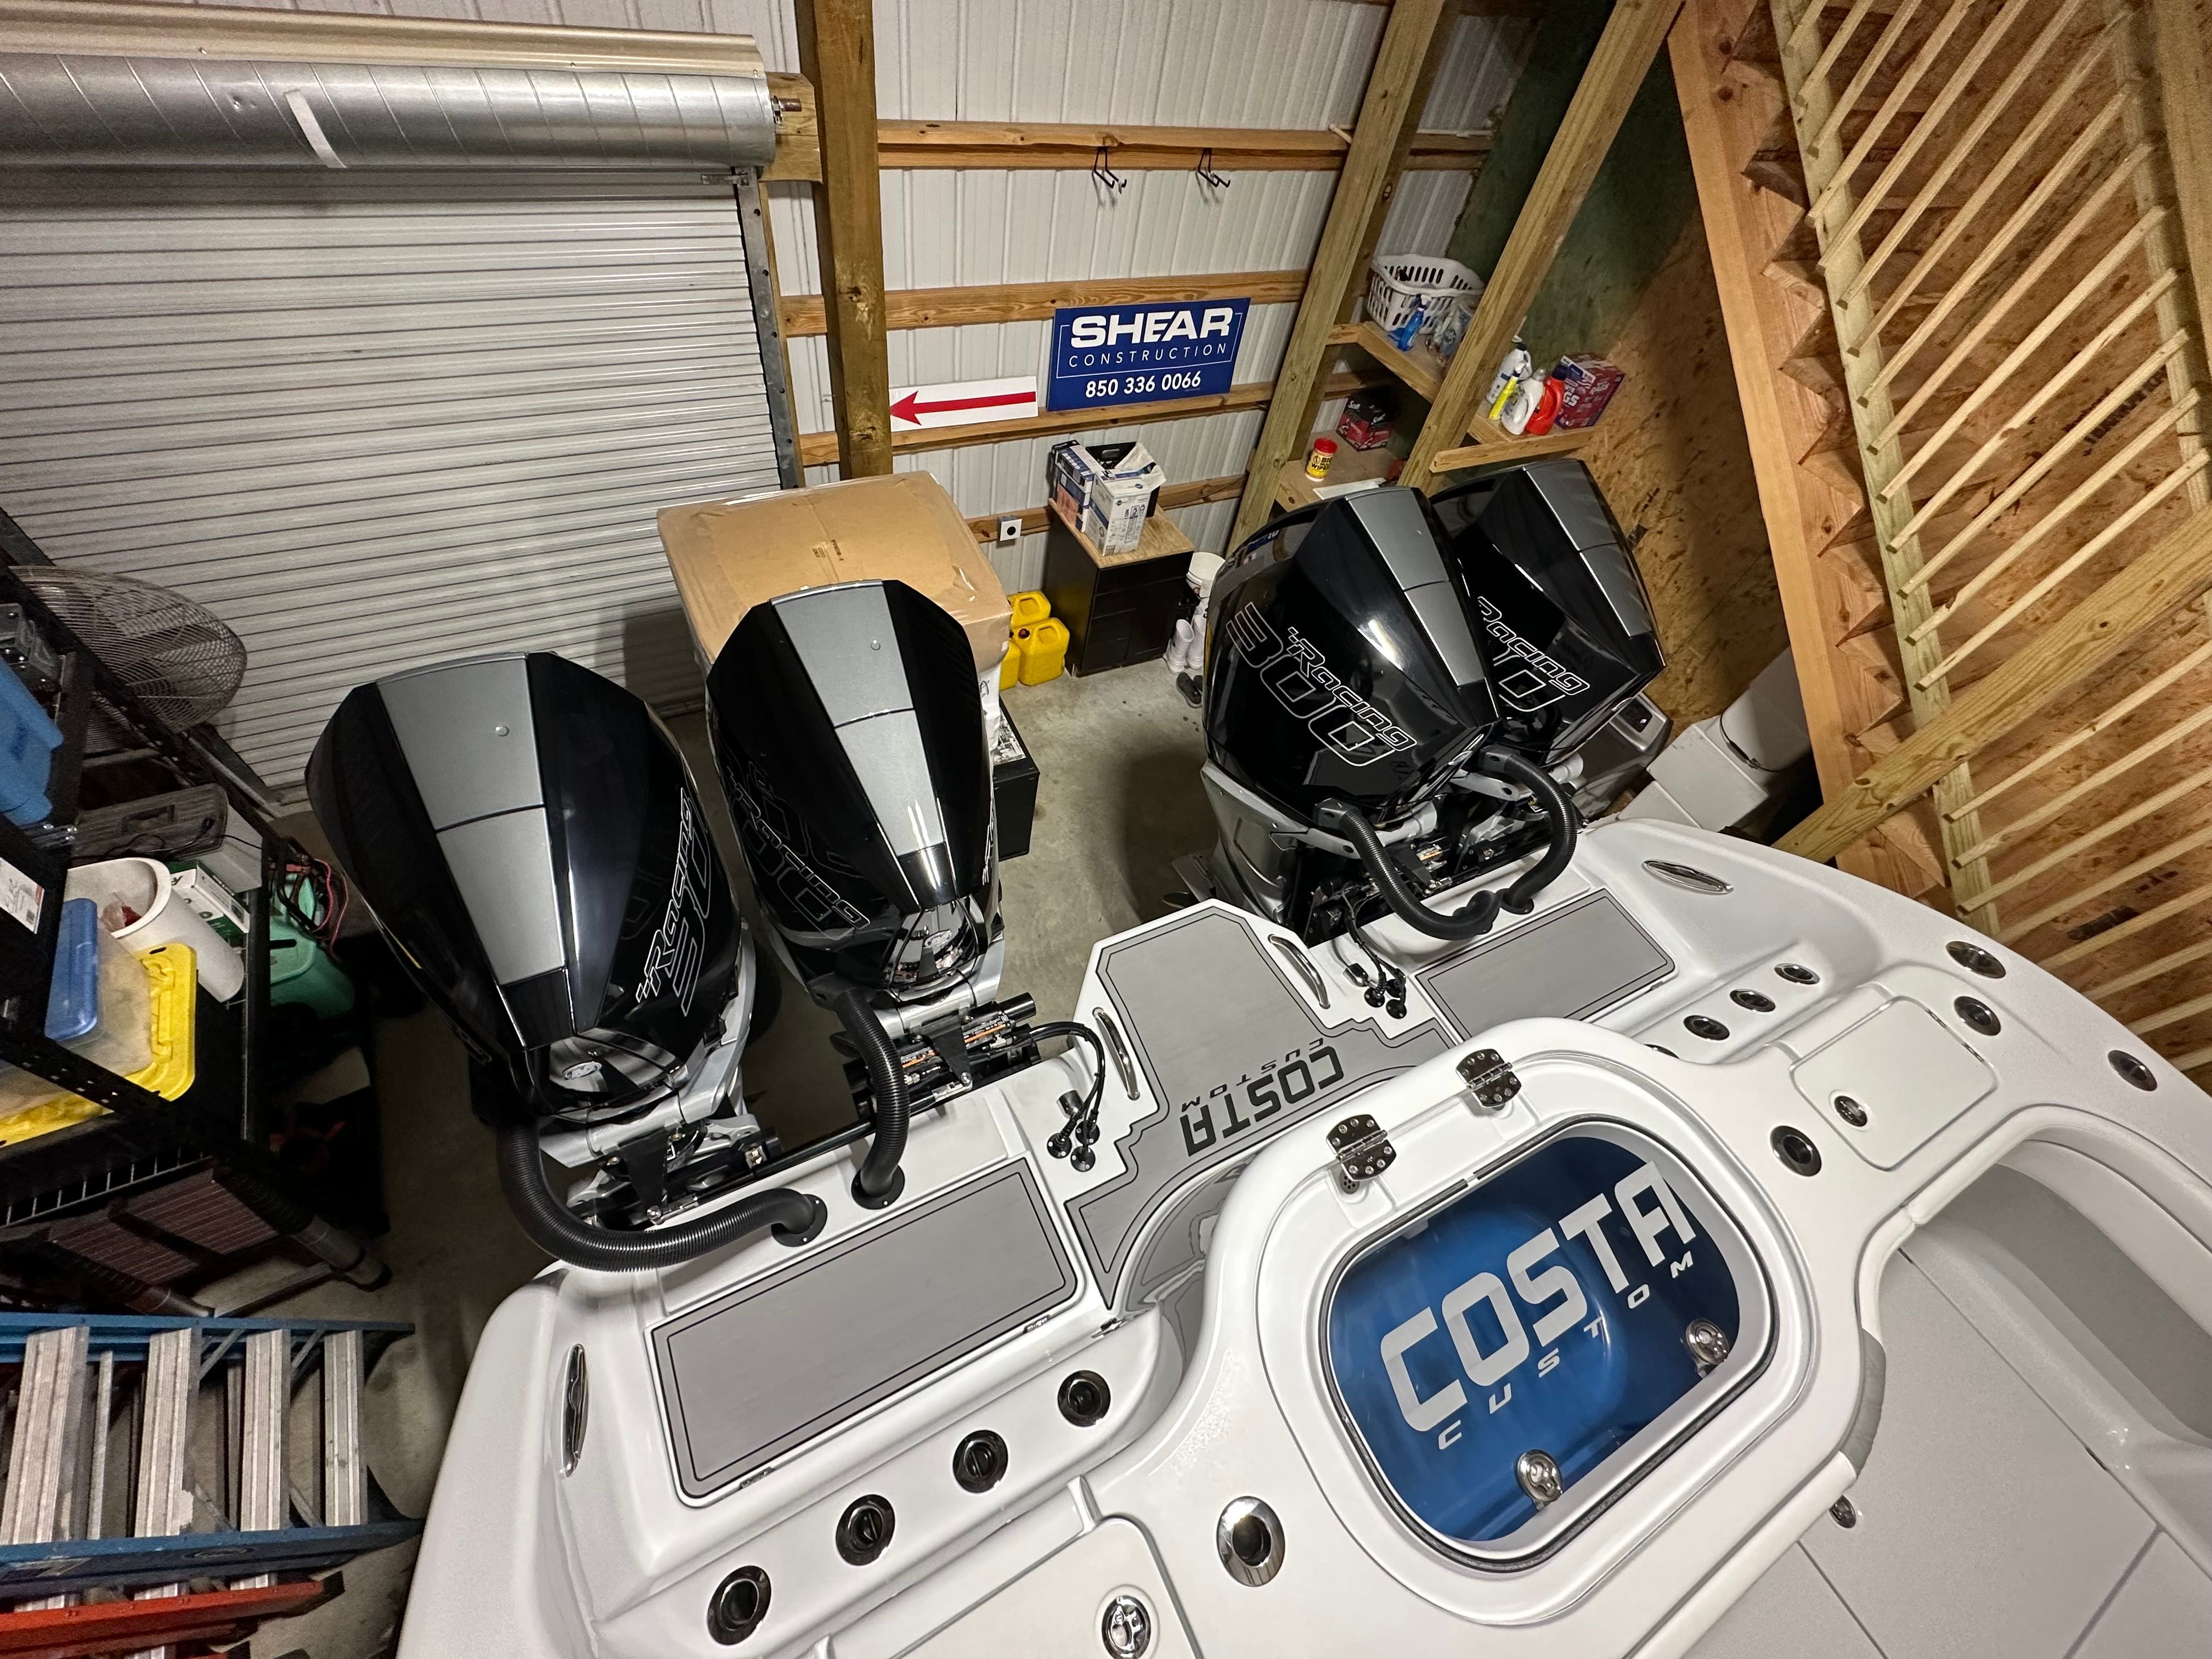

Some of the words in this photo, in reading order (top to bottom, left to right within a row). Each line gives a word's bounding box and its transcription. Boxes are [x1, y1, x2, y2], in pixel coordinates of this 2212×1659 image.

[1069, 343, 1226, 367] CONSTRUCTION
[1071, 307, 1233, 348] SHEAR
[1086, 379, 1118, 398] 850
[1124, 375, 1155, 394] 336
[1161, 371, 1201, 391] 0066
[1226, 602, 1395, 766] 300
[1286, 638, 1417, 751] Racing
[1180, 1046, 1344, 1157] COSTA
[1182, 1037, 1323, 1113] CUSTOM
[1380, 1160, 1696, 1432] COSTA
[1438, 1251, 1693, 1449] CUSTOM
